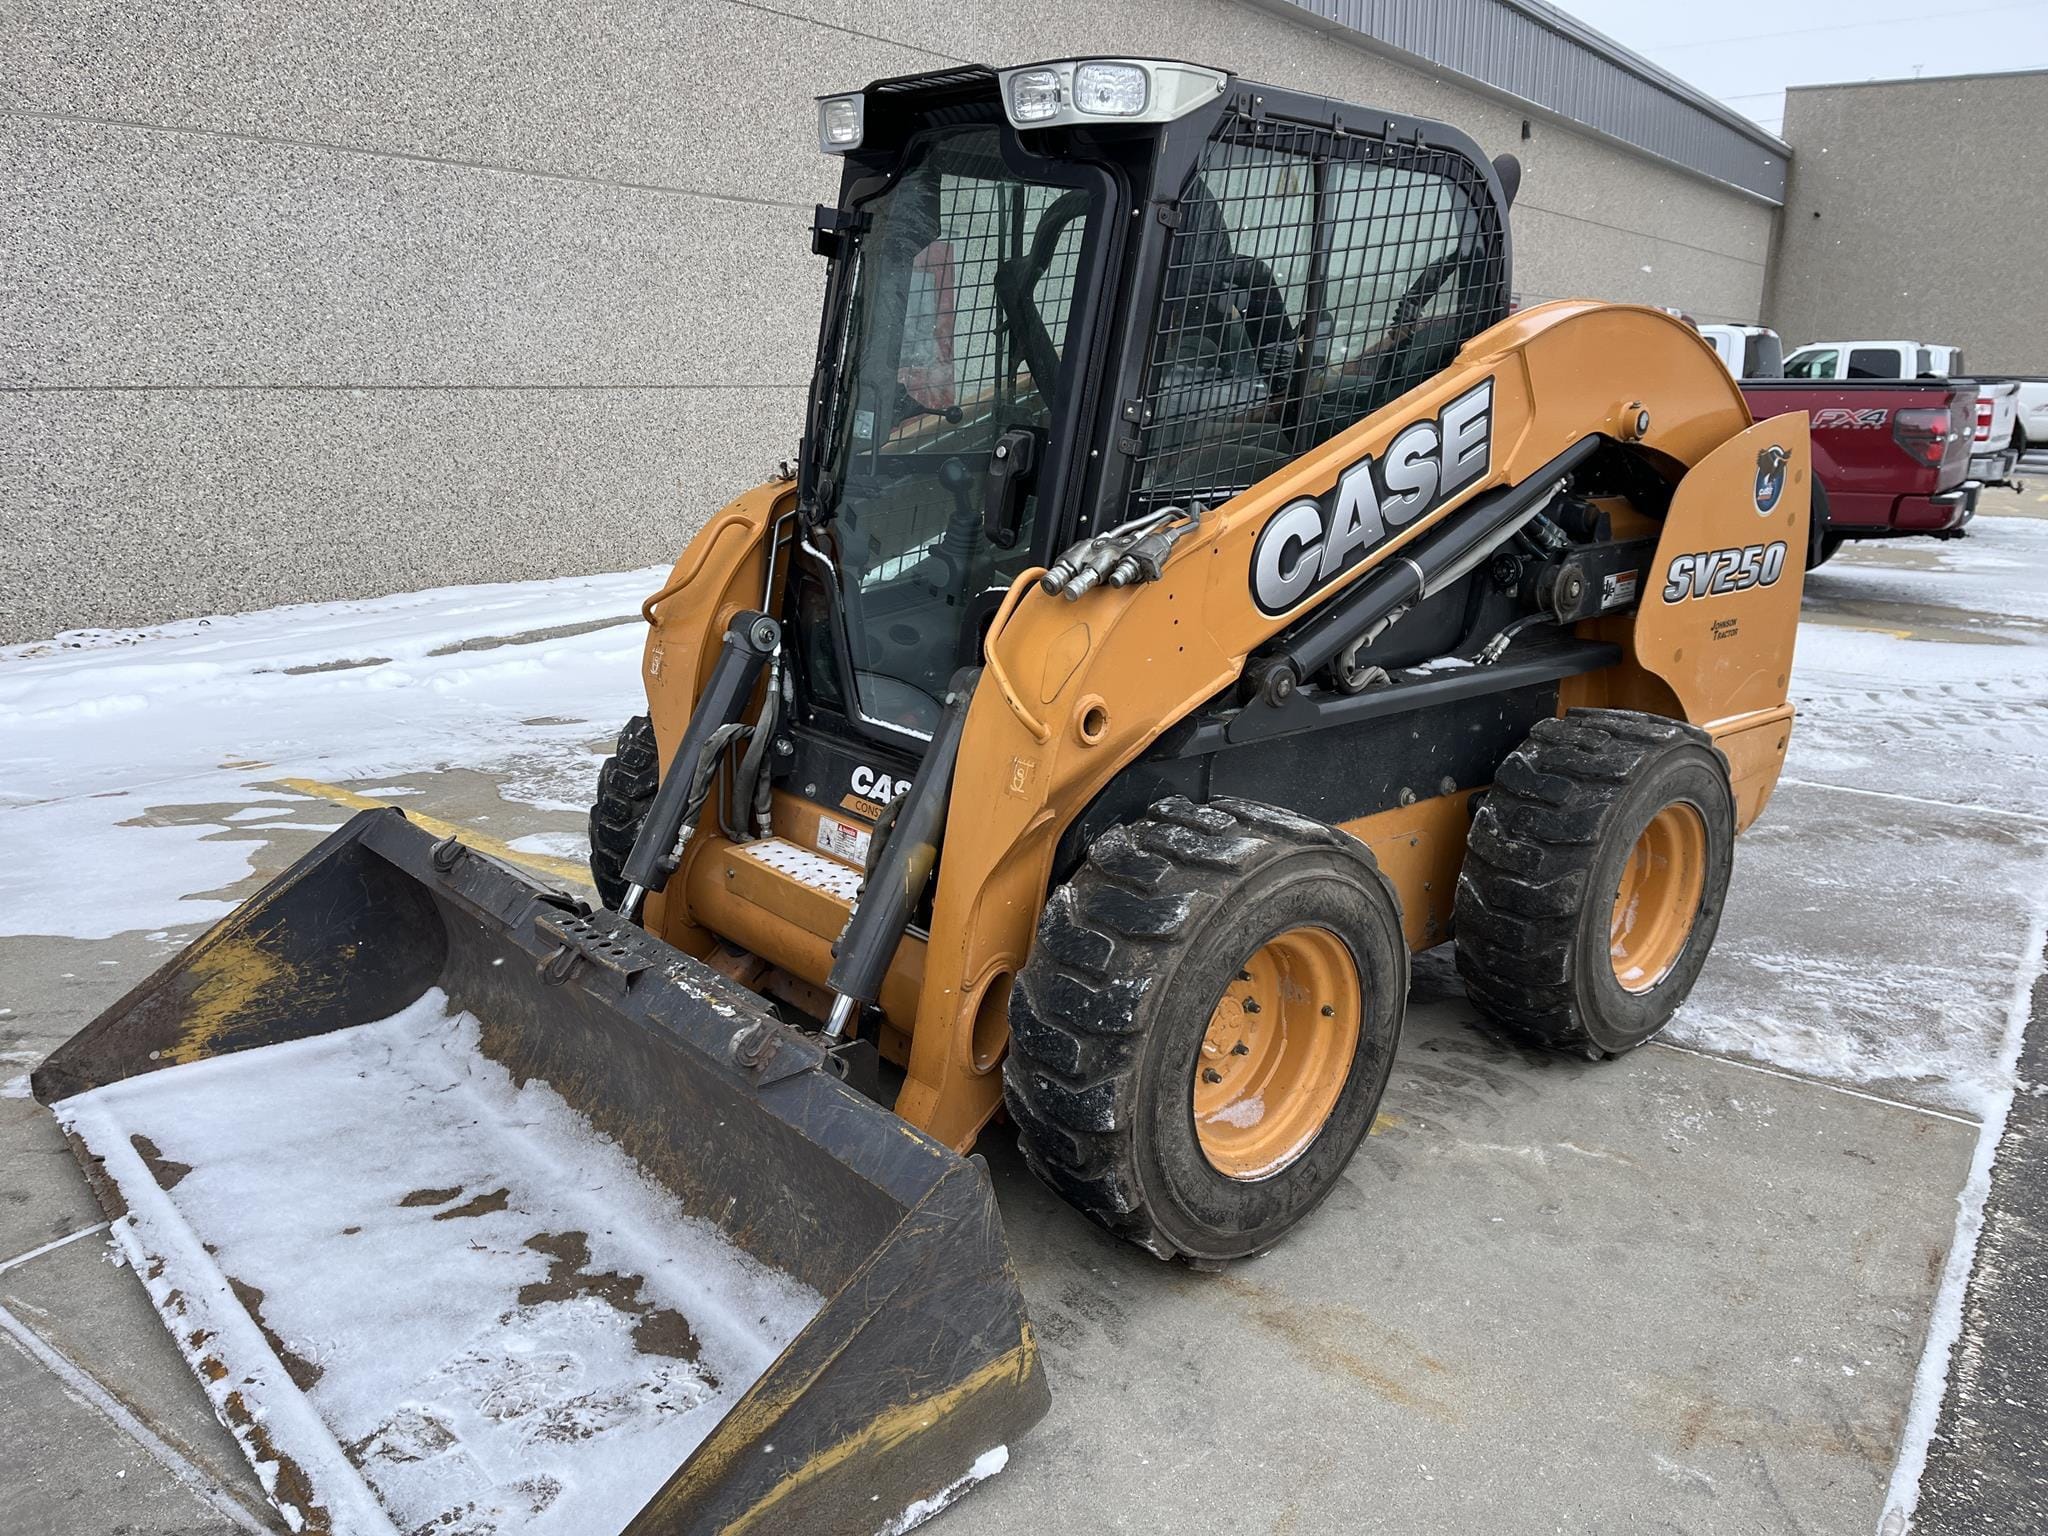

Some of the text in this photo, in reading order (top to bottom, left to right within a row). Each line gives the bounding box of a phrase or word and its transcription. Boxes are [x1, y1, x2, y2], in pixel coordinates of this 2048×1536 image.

[1811, 408, 1888, 425] FX4
[1252, 376, 1493, 613] CASE
[1663, 541, 1788, 604] SV250
